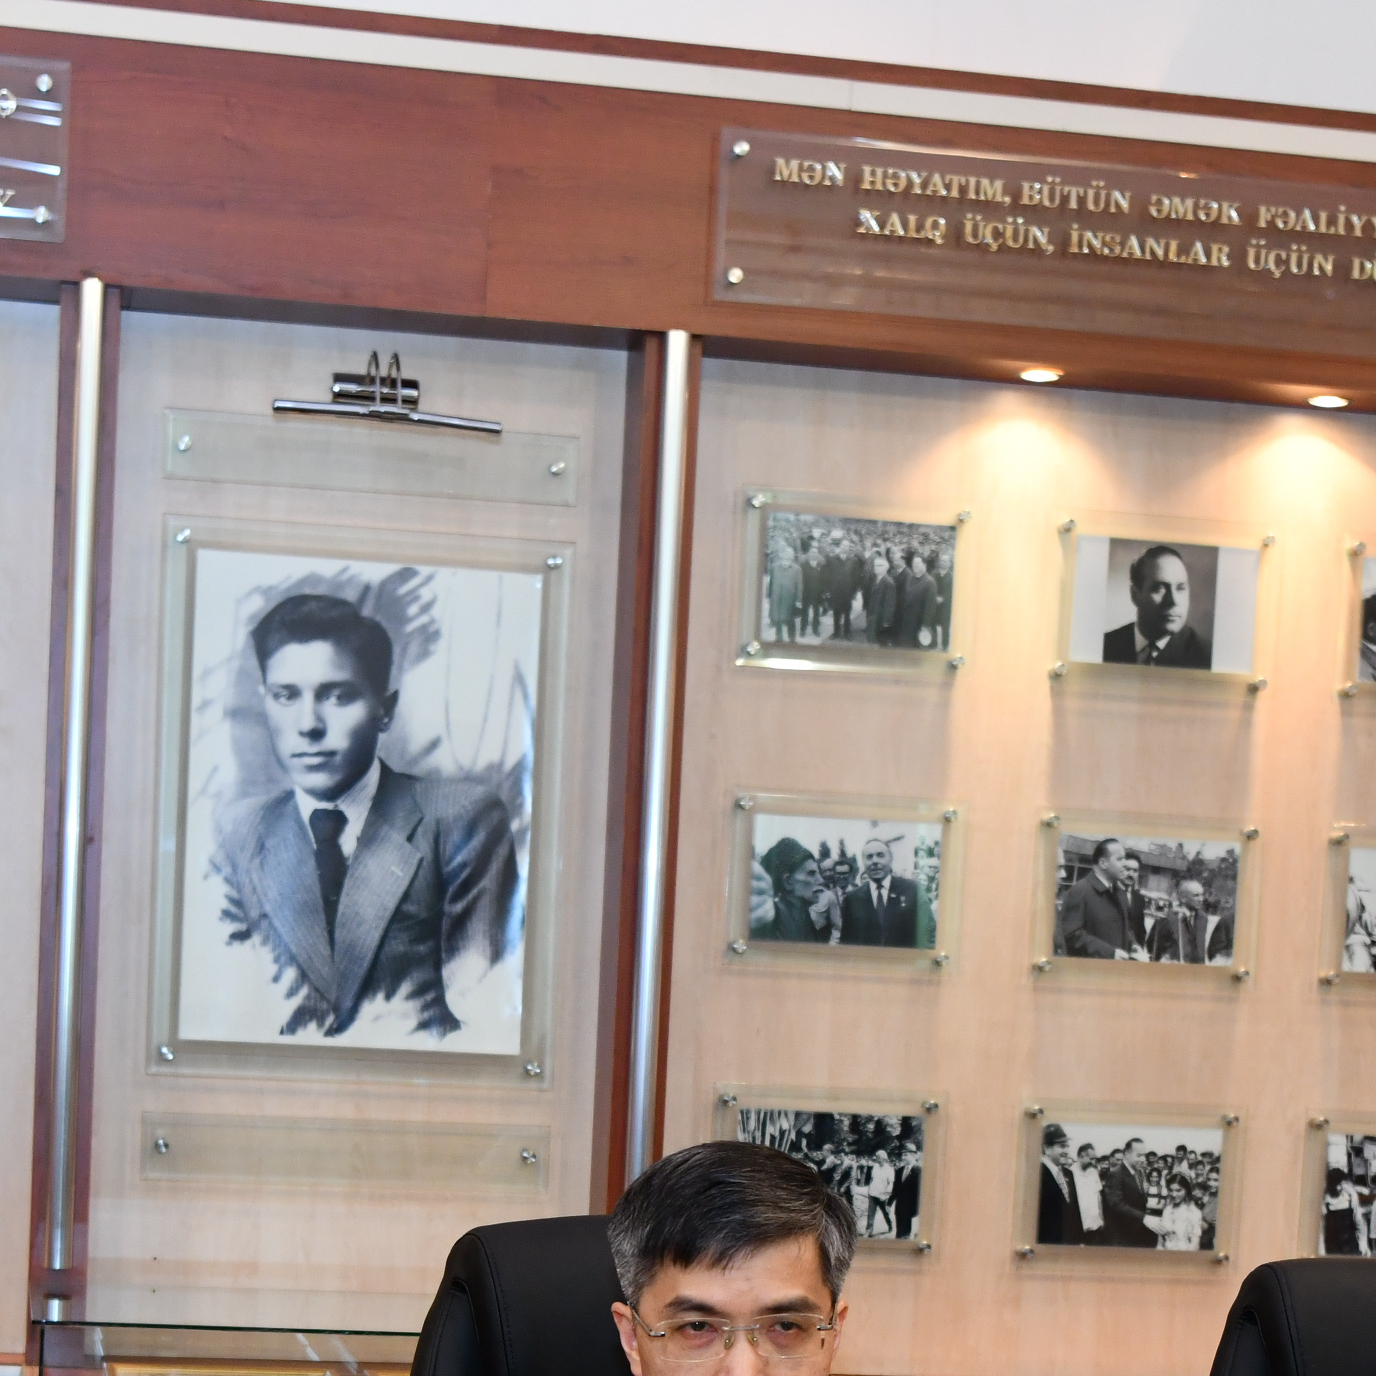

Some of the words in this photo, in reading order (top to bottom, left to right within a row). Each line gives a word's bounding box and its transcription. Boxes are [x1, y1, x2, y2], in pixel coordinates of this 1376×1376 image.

[774, 157, 846, 187] MƏN
[861, 165, 1011, 207] HƏYATIM,
[1019, 175, 1131, 214] BÜTÜN
[1148, 194, 1241, 226] ƏMƏK
[857, 208, 947, 245] XALQ
[964, 213, 1055, 255] ÜÇÜN,
[1069, 223, 1230, 268] İNSANLAR
[1246, 239, 1335, 279] ÜÇÜN
